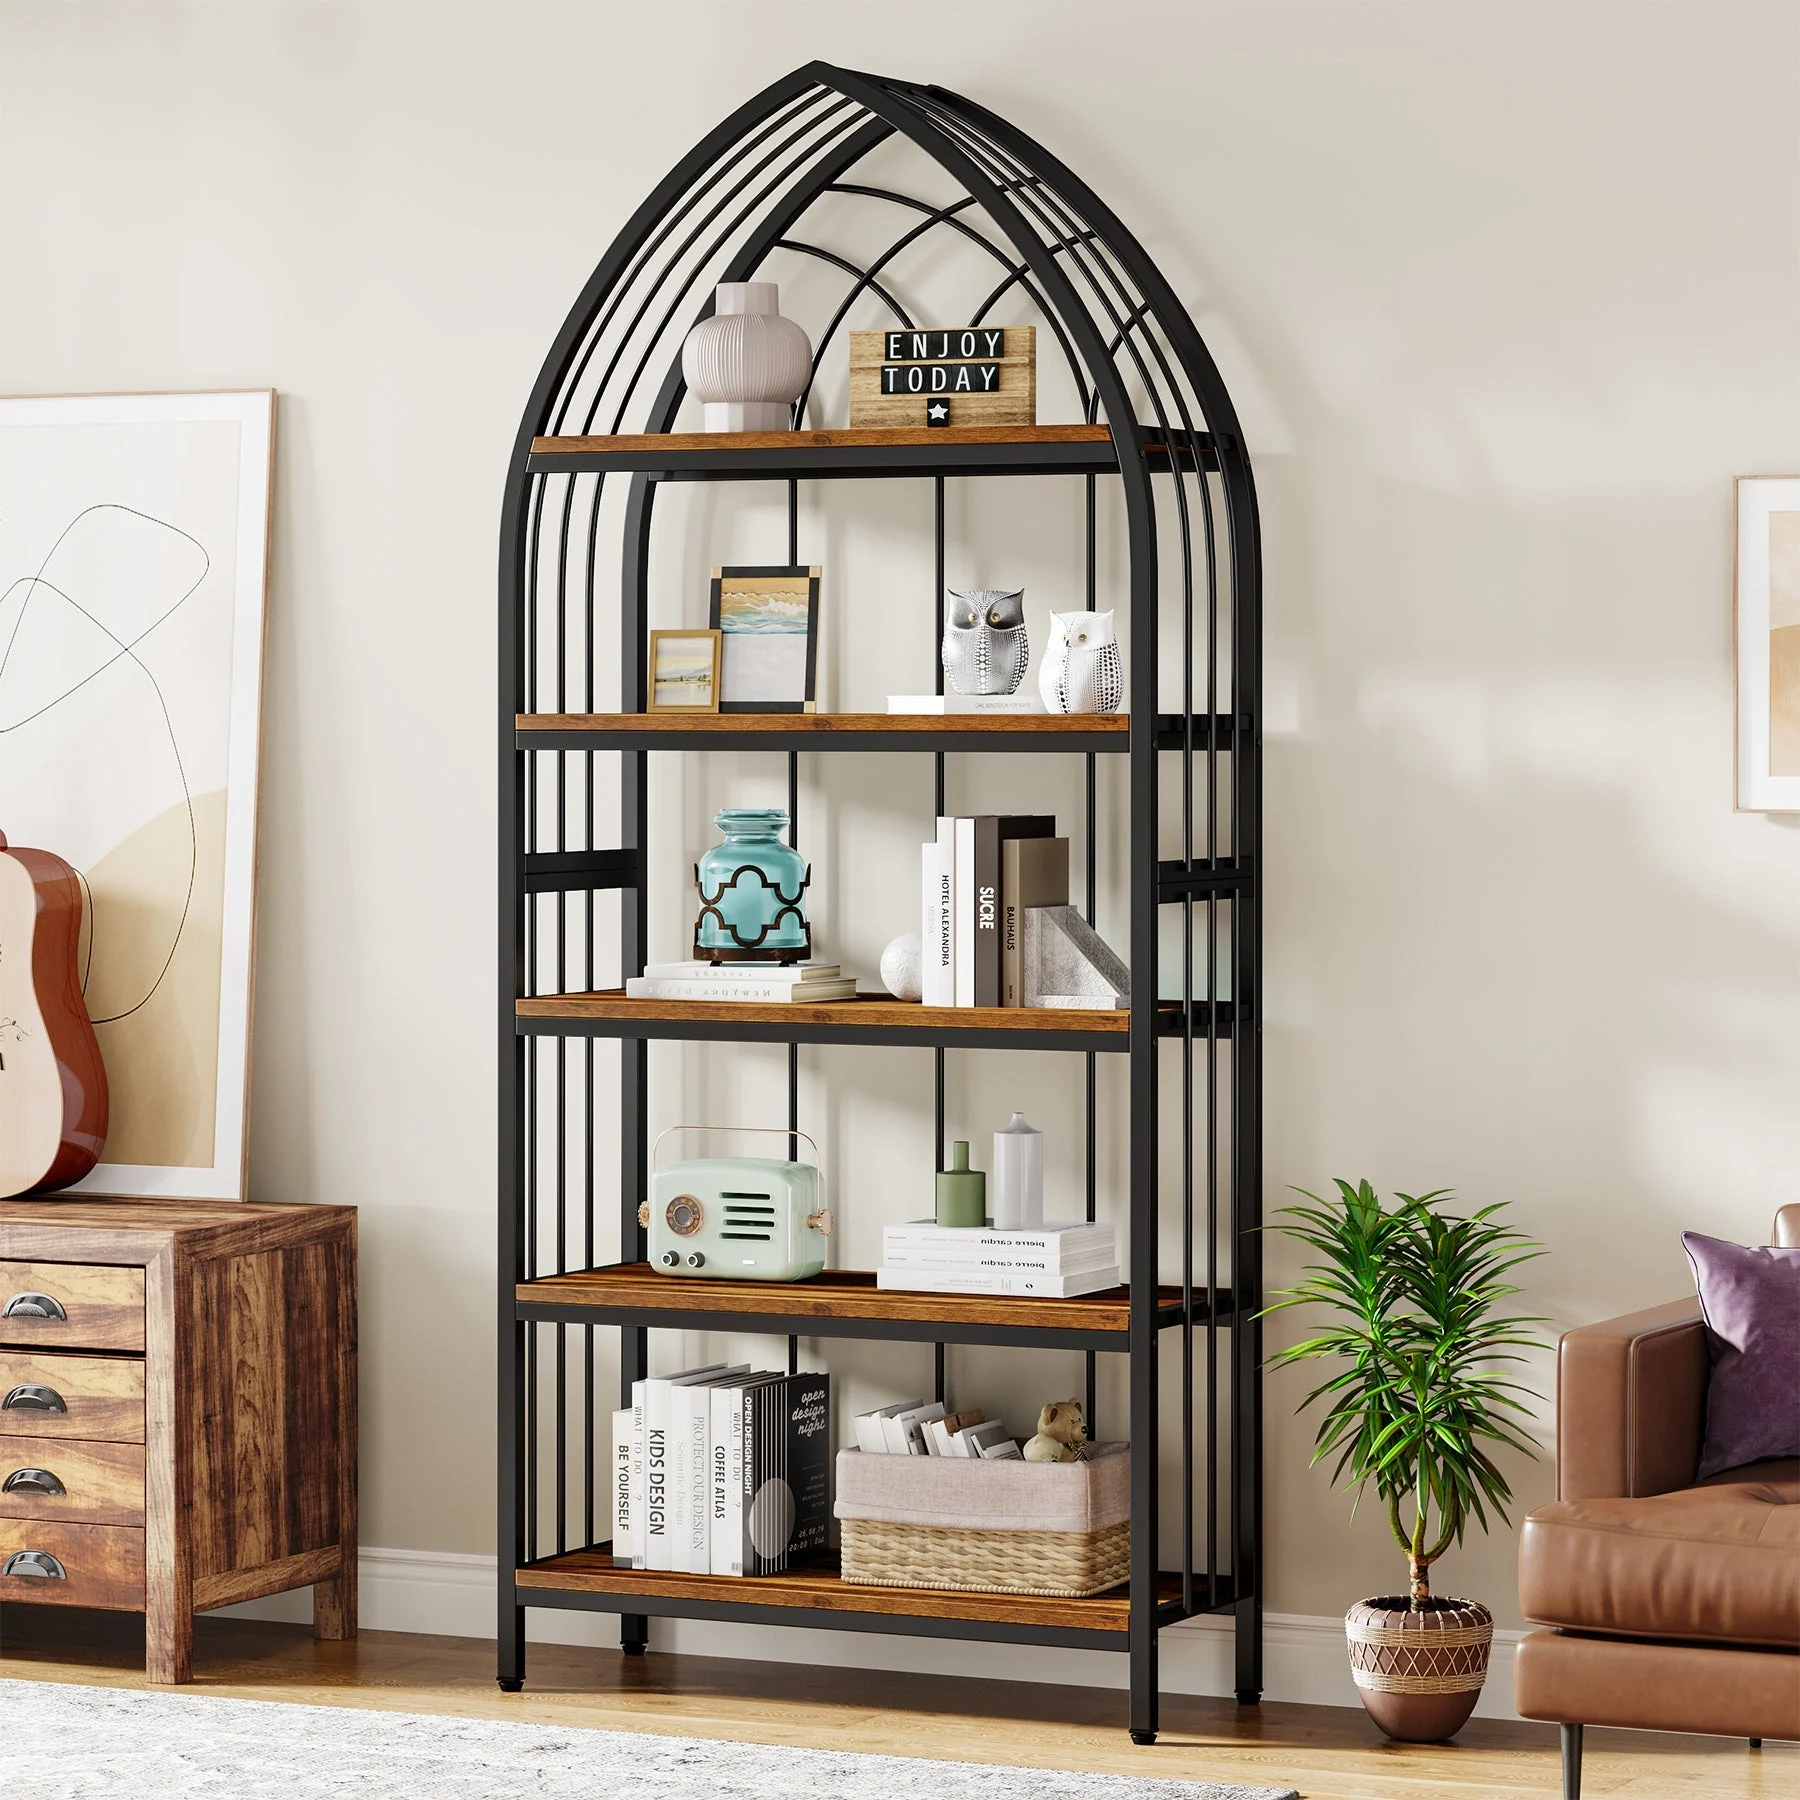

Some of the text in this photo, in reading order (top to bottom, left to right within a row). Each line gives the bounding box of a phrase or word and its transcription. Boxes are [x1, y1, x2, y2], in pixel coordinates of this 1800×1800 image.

[889, 332, 1000, 359] ENJOY
[884, 366, 996, 392] TODAY
[941, 875, 950, 967] HOTEL ALEXANDRA
[979, 886, 995, 930] SUCRE
[1006, 906, 1015, 951] BAUHAUS
[801, 1390, 826, 1407] open
[634, 1406, 642, 1432] WHAT
[733, 1412, 742, 1438] WHAT
[791, 1403, 826, 1421] design
[797, 1418, 826, 1437] night
[634, 1442, 642, 1454] TO
[733, 1448, 741, 1461] TO
[744, 1396, 753, 1496] OPEN DESIGN NIGHT
[634, 1460, 642, 1474] DO
[733, 1466, 741, 1481] DO
[618, 1445, 629, 1531] BE YOURSELF
[649, 1429, 665, 1535] KIDS DESIGN
[692, 1416, 705, 1550] PROTECT OUR DESIGN
[714, 1445, 726, 1519] COFFEE ATLAS
